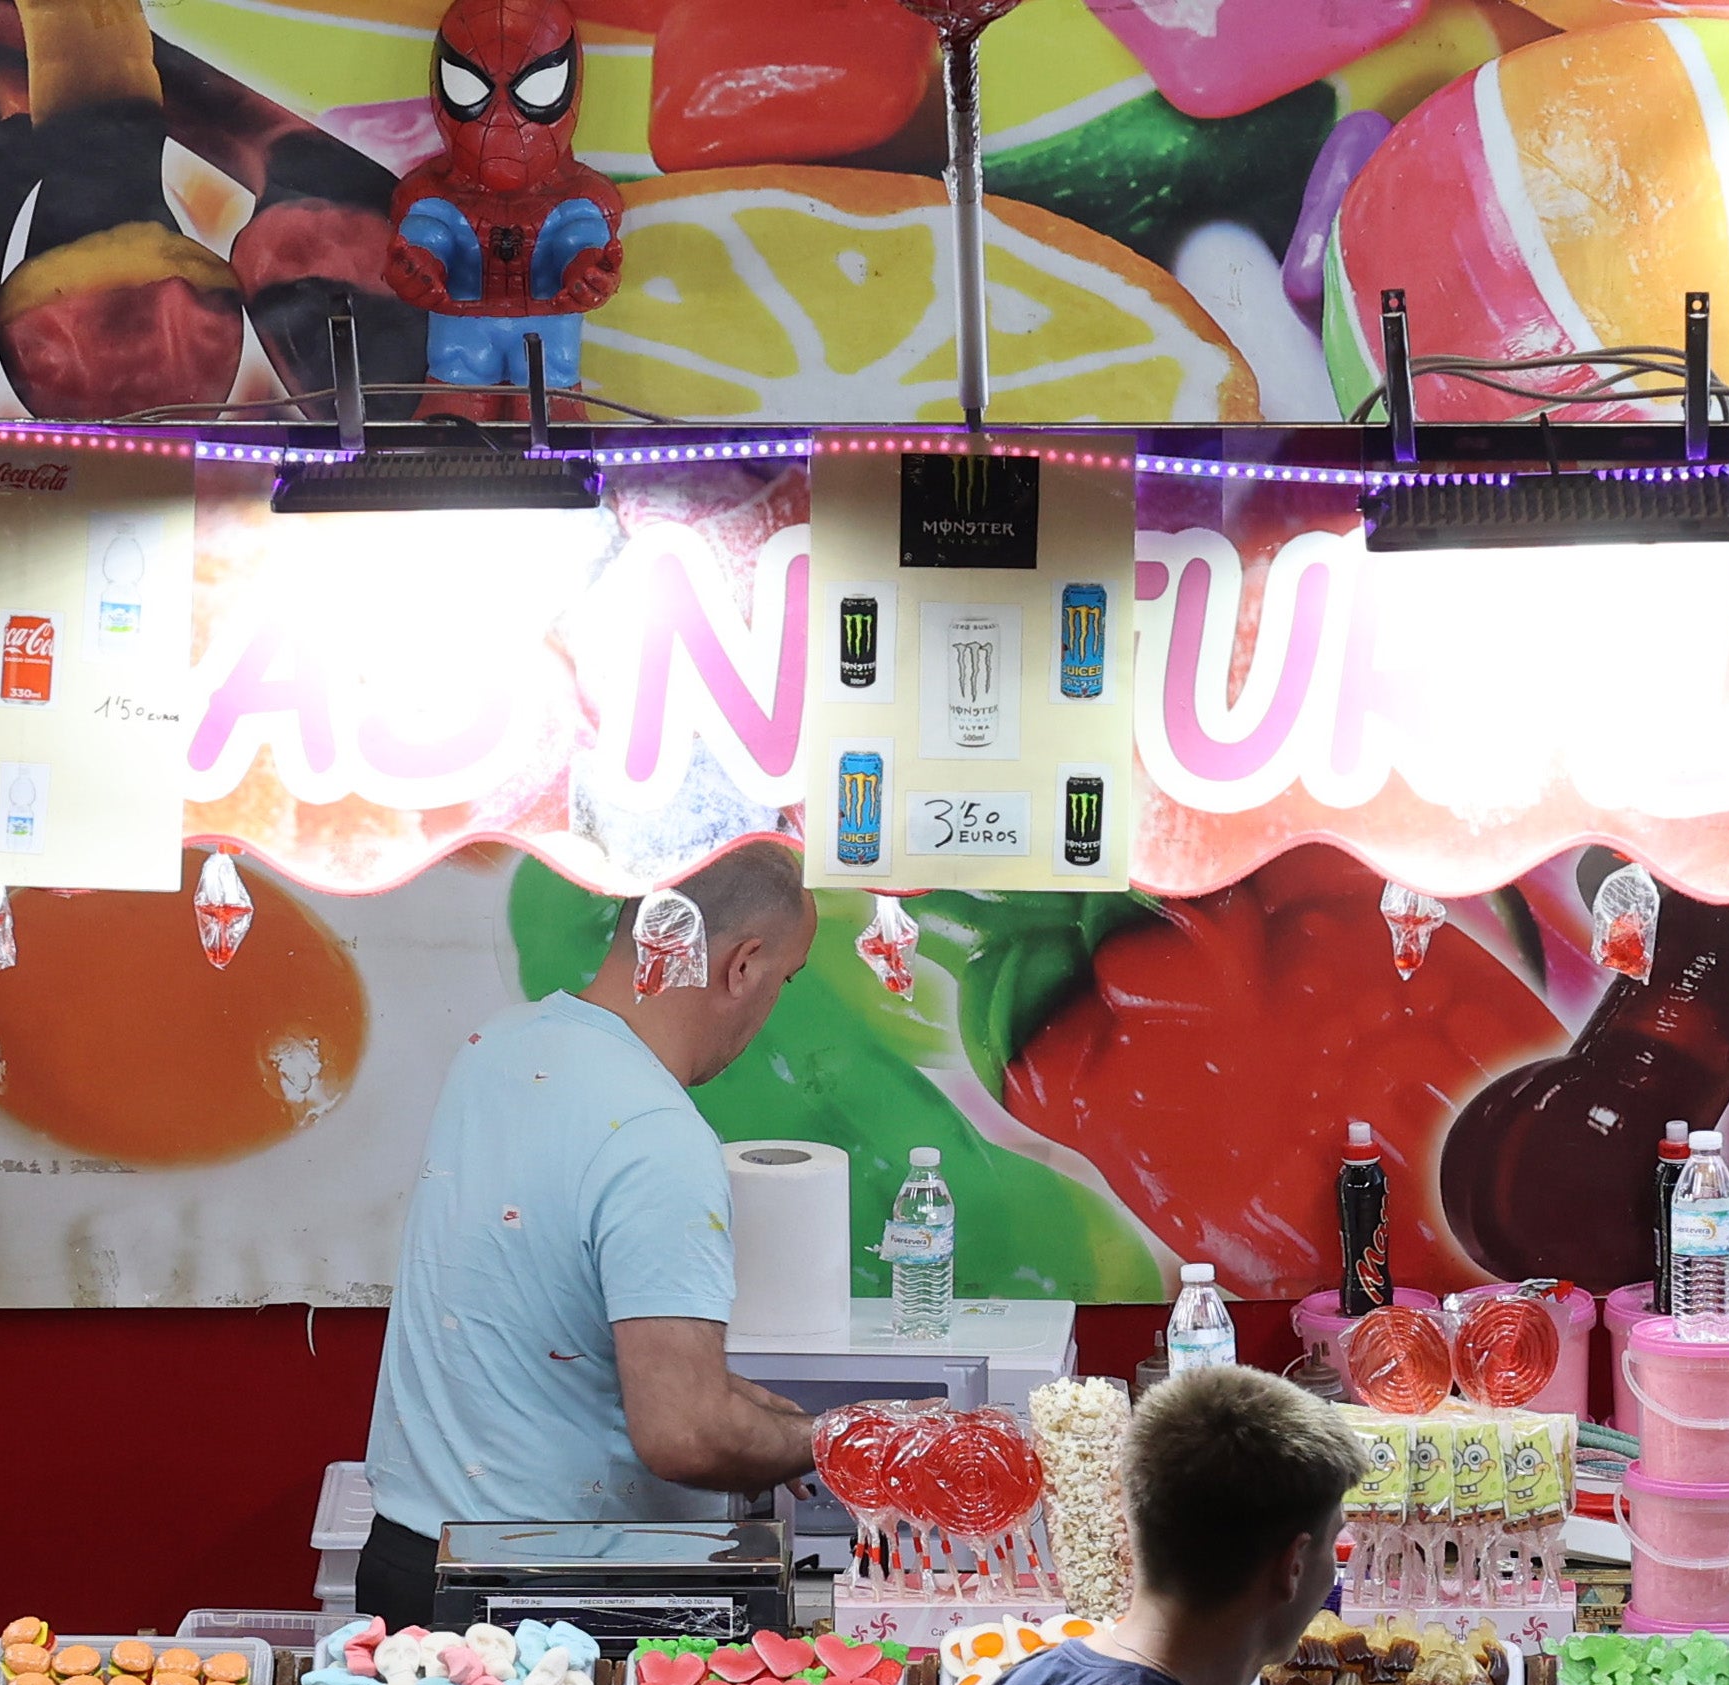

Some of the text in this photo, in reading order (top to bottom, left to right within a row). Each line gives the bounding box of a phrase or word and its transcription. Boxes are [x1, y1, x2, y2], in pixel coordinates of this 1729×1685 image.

[922, 518, 1016, 537] MONSTER
[962, 734, 986, 742] 500ml
[958, 830, 1018, 845] EUROS
